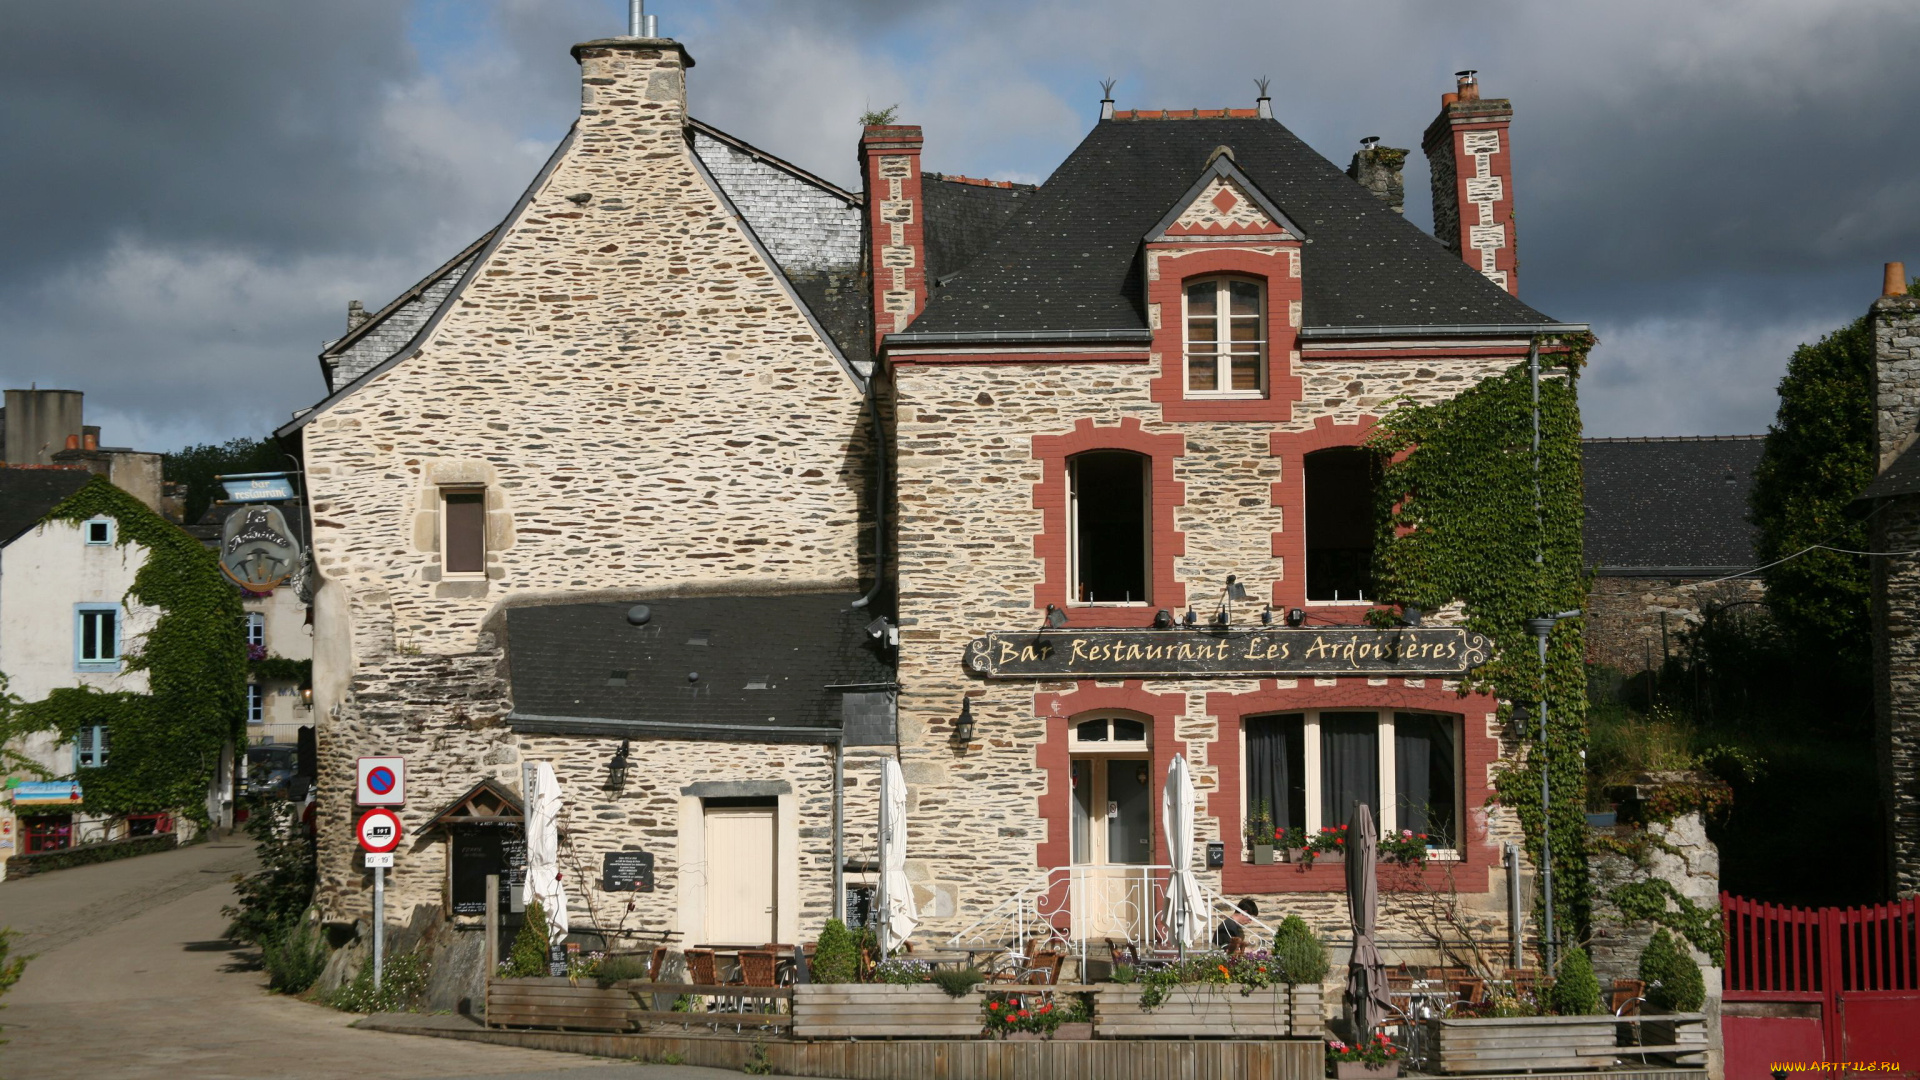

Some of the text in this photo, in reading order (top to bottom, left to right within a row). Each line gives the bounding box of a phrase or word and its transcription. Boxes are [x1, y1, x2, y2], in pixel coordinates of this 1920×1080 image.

[234, 487, 287, 500] restaurant
[998, 633, 1457, 669] Bar Restaurant Les Ardoisières
